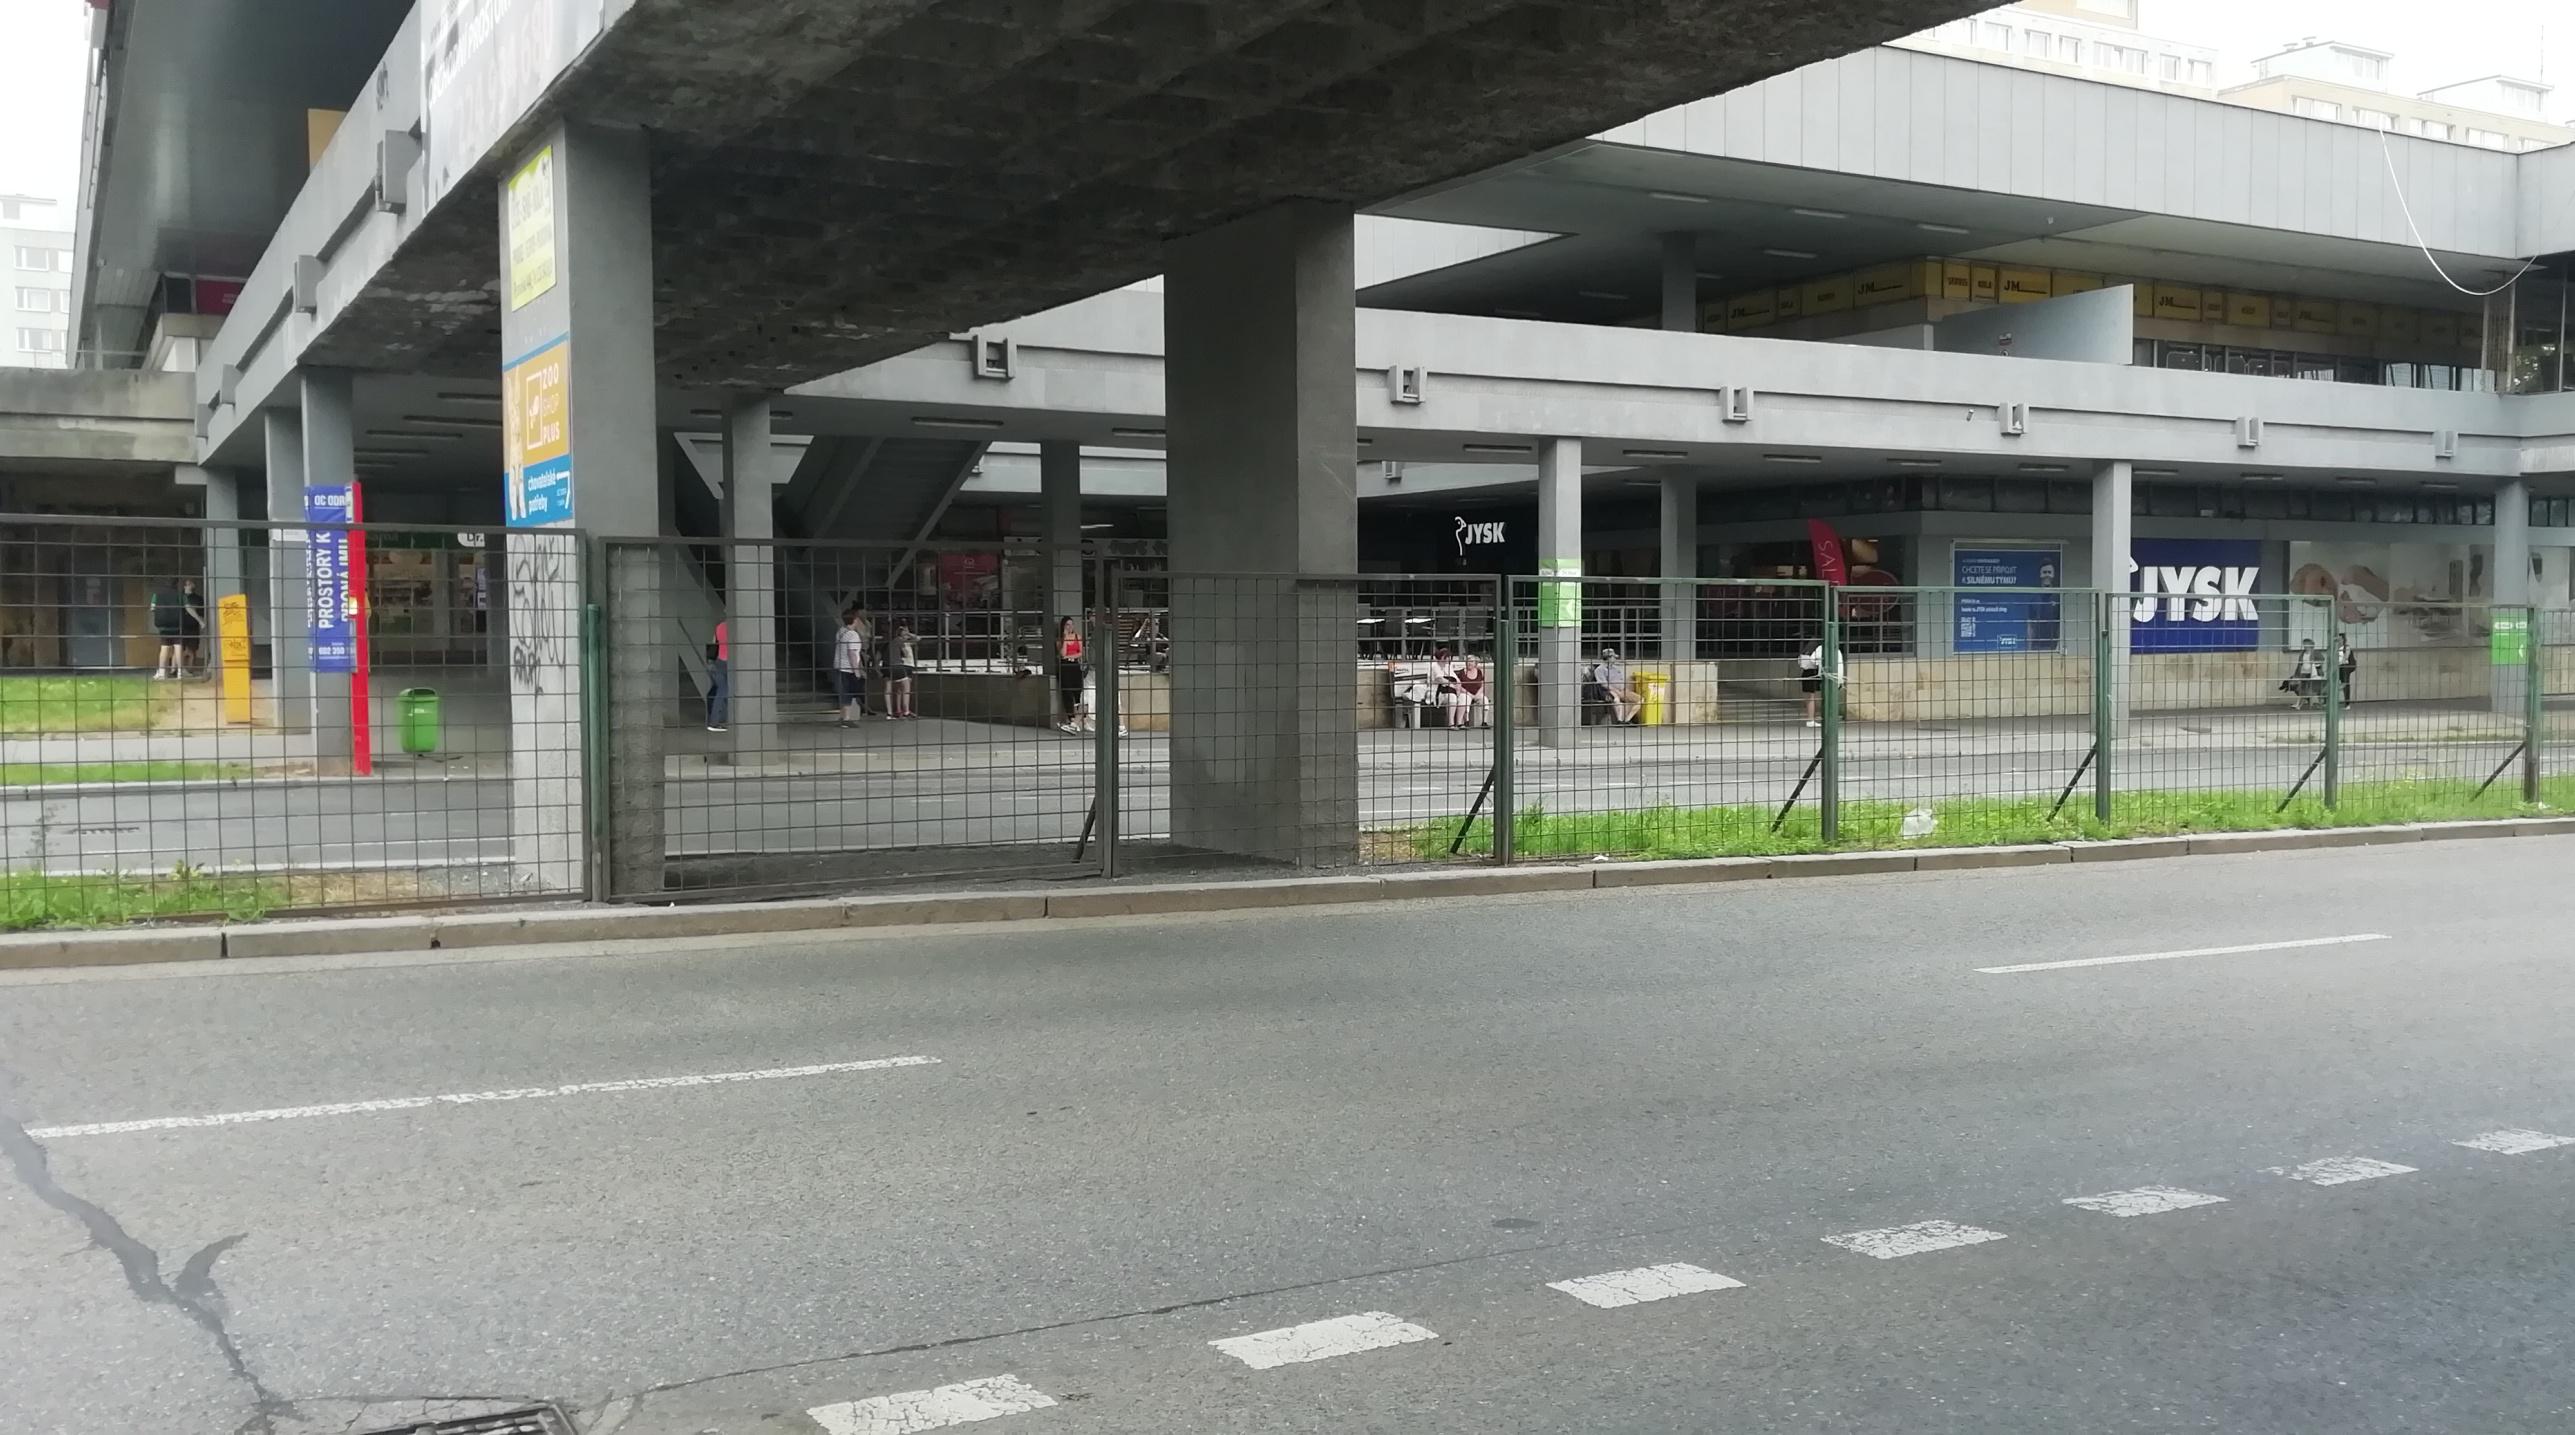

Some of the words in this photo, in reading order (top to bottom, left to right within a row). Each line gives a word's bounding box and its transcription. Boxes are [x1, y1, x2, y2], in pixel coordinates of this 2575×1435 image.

[2004, 280, 2021, 291] JM
[542, 362, 559, 390] ZOO
[543, 421, 560, 445] PLUS
[316, 532, 331, 543] K
[1465, 522, 1505, 545] JYSK
[1818, 540, 1841, 587] SAL
[316, 549, 334, 629] PROSTORY
[2133, 566, 2260, 623] JYSK
